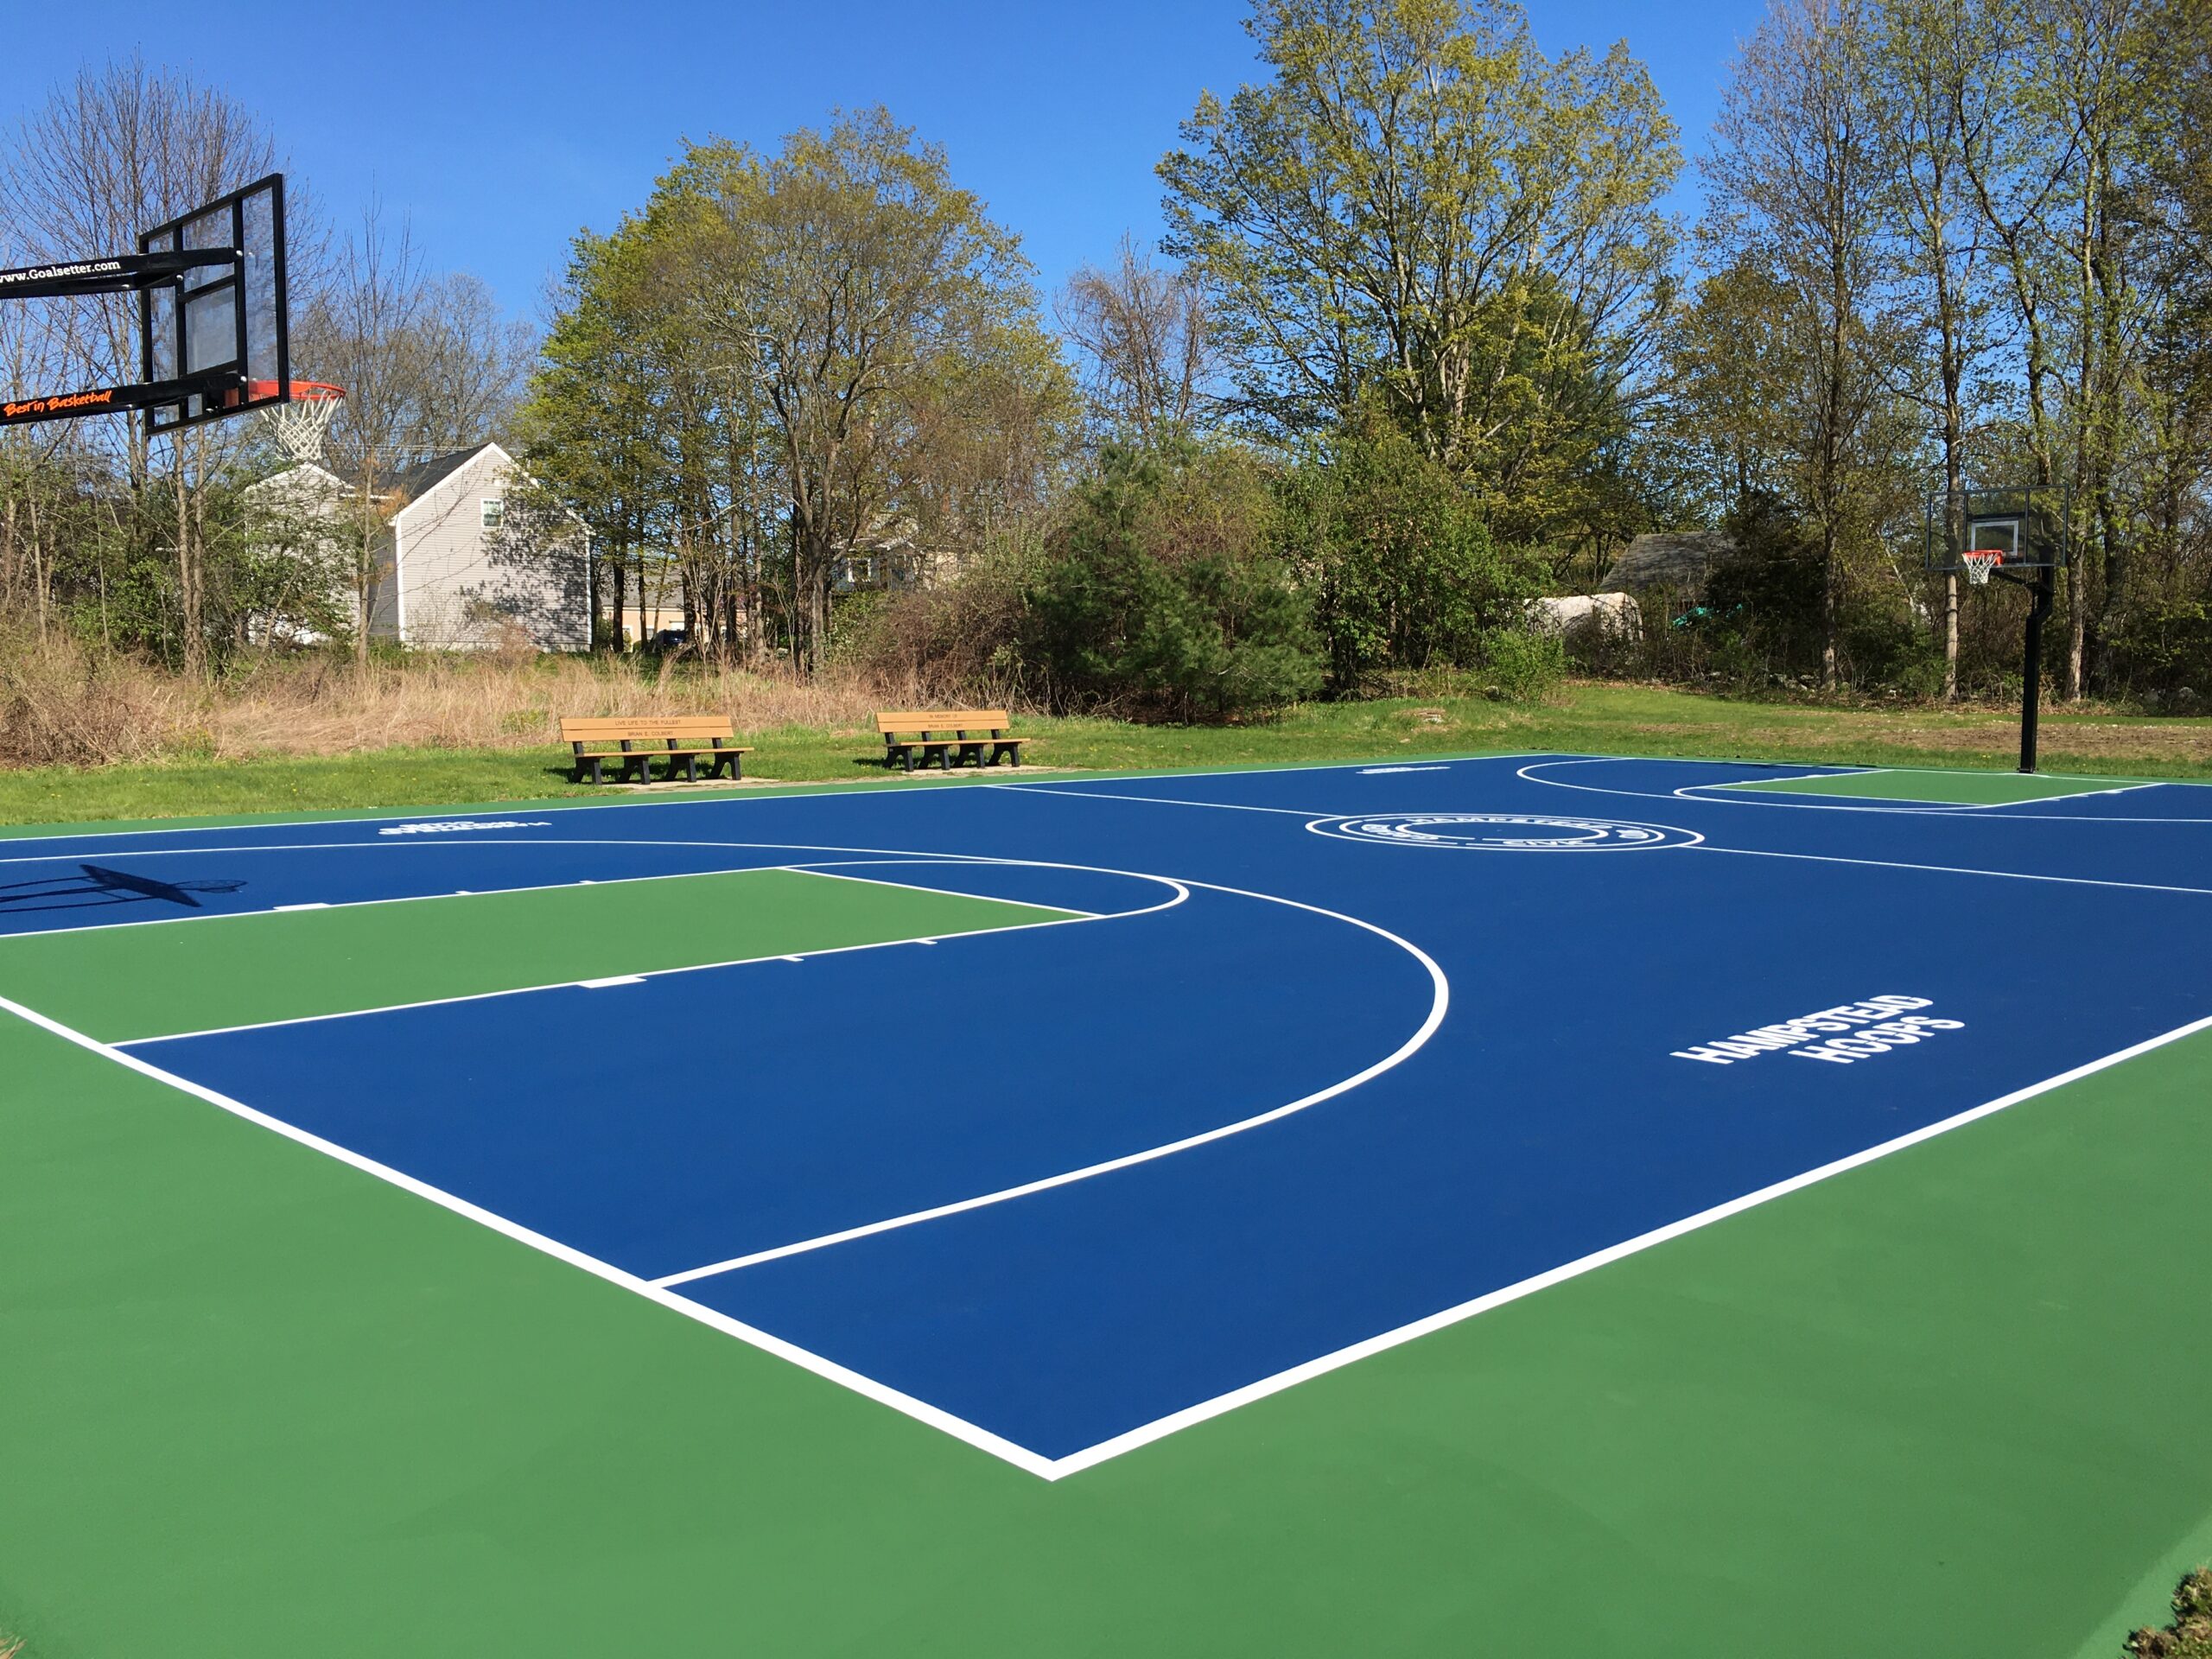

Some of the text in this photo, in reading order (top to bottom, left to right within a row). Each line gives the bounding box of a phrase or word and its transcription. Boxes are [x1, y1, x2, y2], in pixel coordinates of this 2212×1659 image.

[0, 261, 121, 283] ww.Goalsetter.com
[3, 390, 112, 416] Best in Basketball
[1669, 994, 1935, 1065] HAMPSTEAD
[1788, 1015, 1966, 1065] HOOPS
